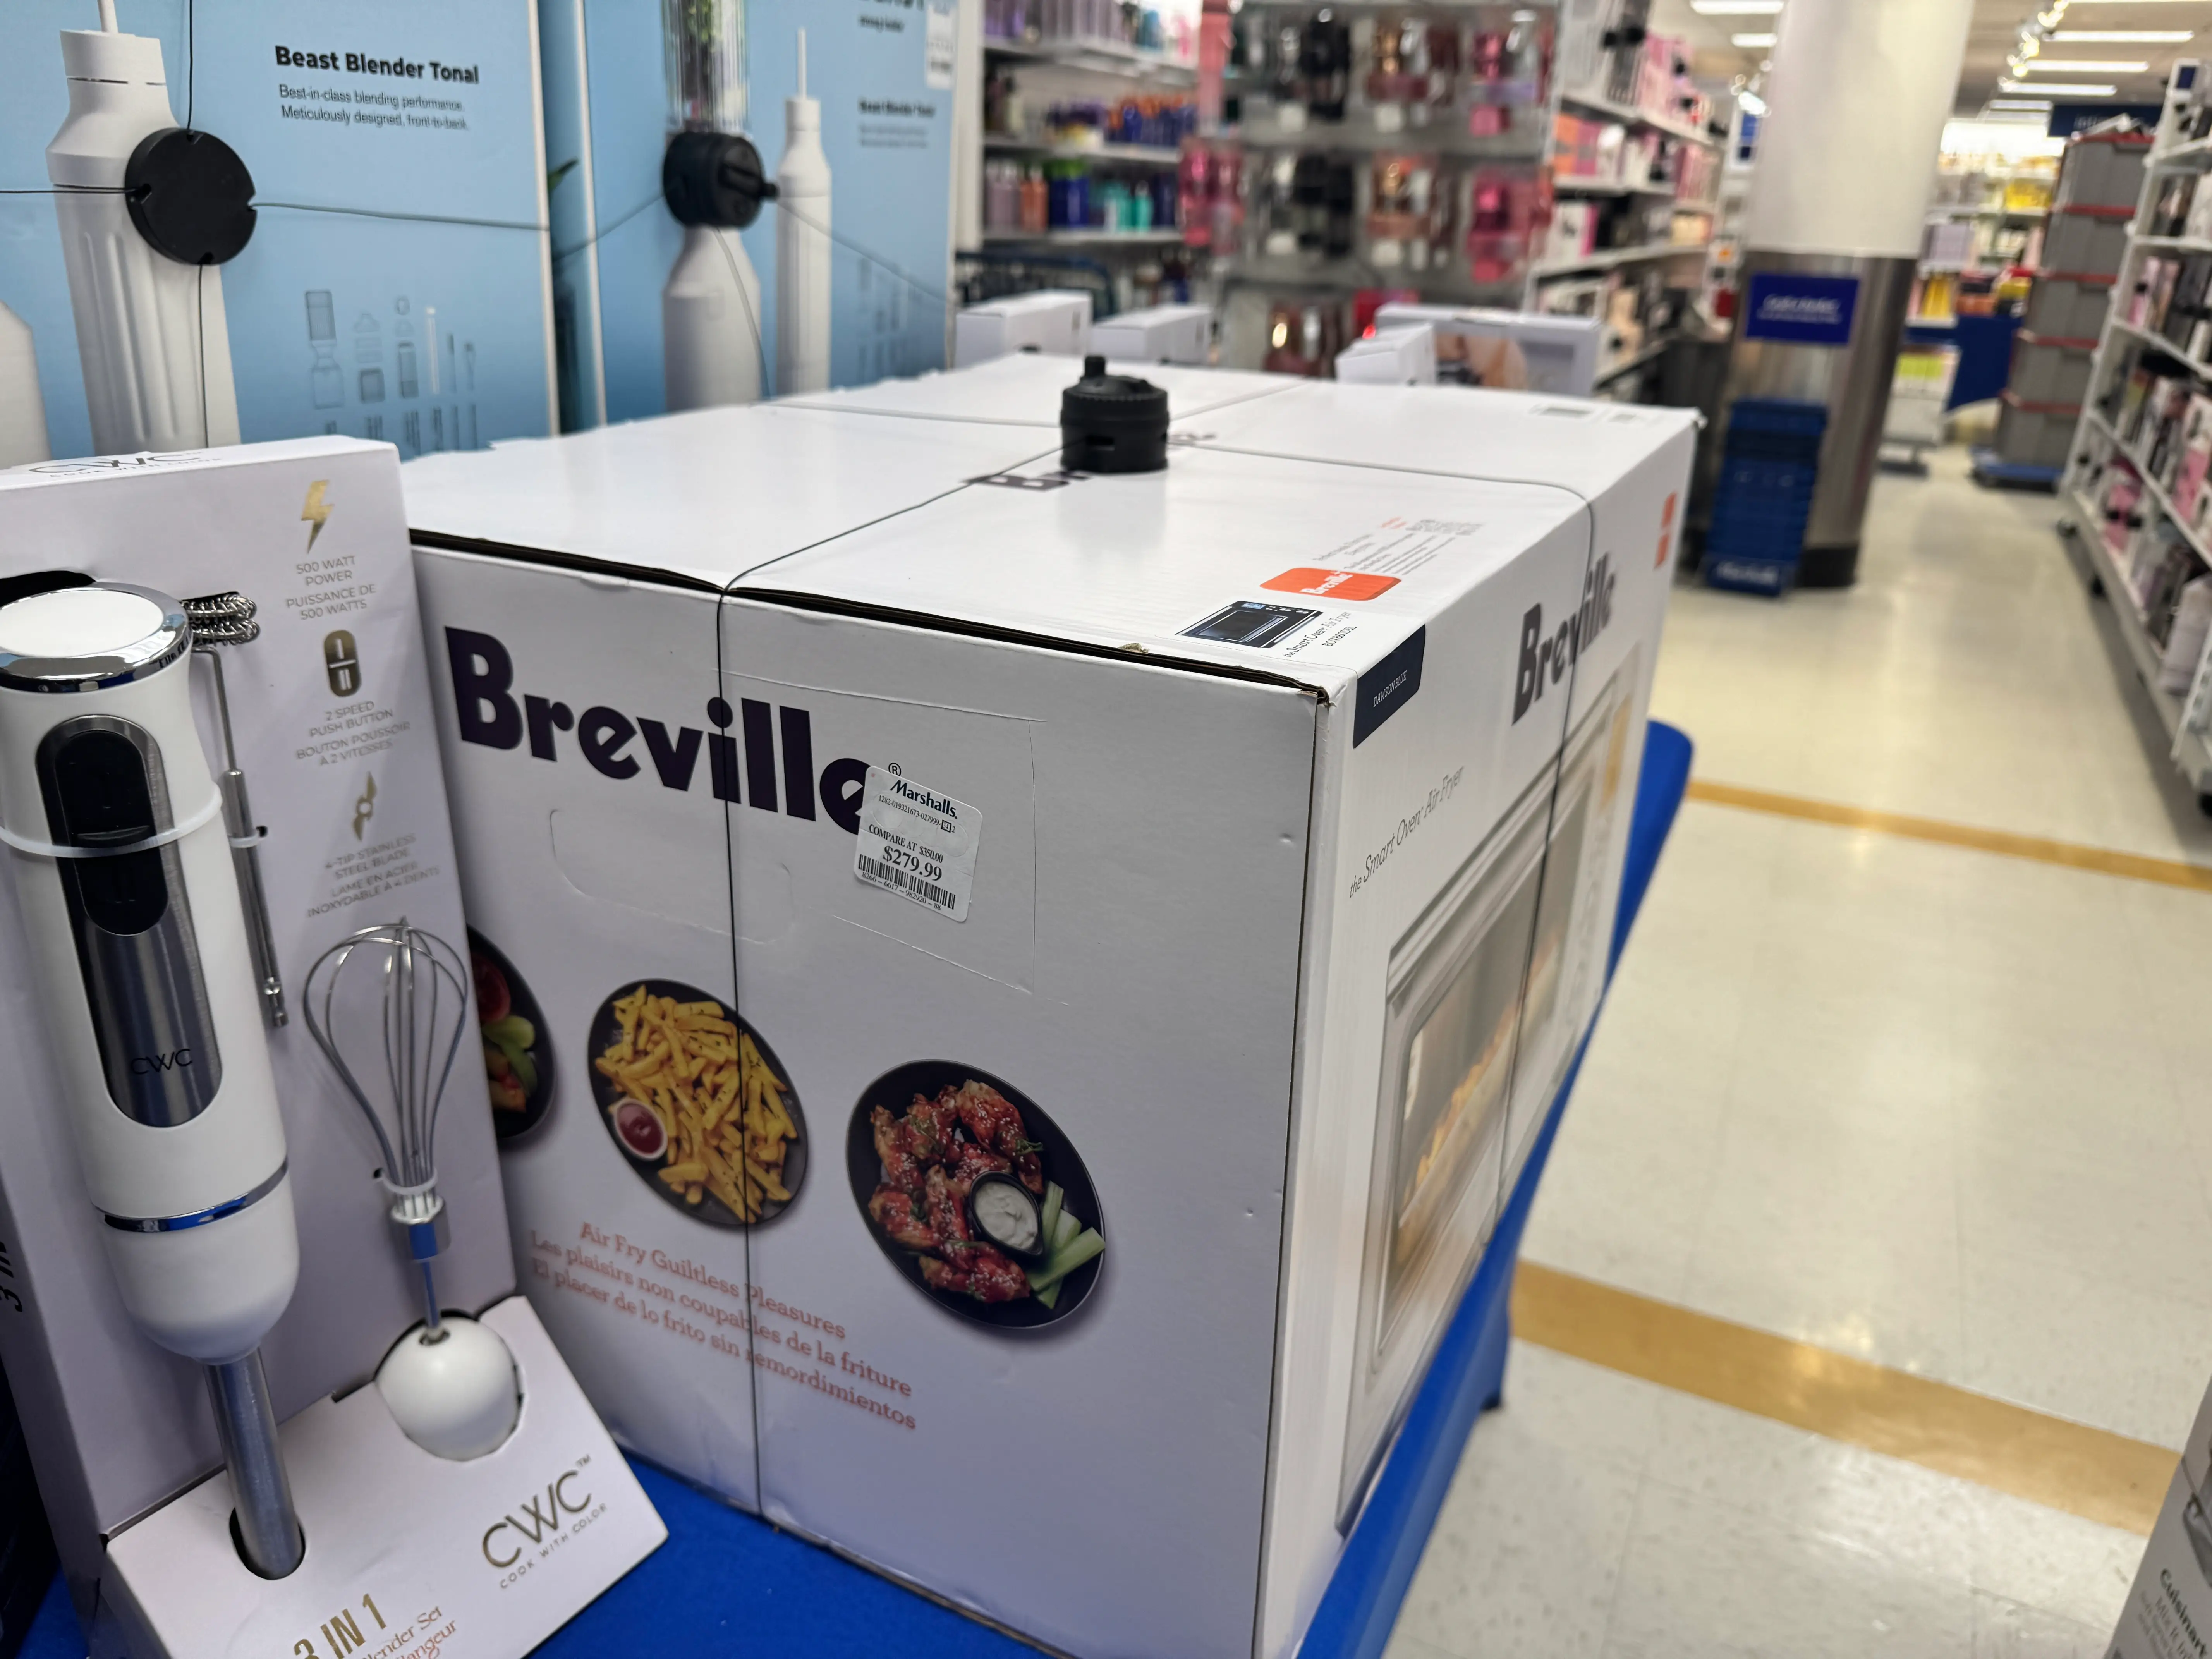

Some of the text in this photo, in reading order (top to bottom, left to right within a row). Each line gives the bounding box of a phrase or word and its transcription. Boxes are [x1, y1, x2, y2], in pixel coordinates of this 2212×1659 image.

[275, 46, 479, 84] Beast Blender Tonal
[279, 84, 351, 103] Best-in-class
[354, 89, 399, 110] blending
[281, 105, 351, 126] Meticulously
[354, 110, 405, 127] designed,
[296, 556, 356, 574] 500 WATT
[305, 569, 352, 587] POWER
[286, 584, 376, 608] PUISSANCE DE
[301, 599, 367, 620] 500 WATTS
[1286, 639, 1313, 652] Smart
[1373, 670, 1408, 708] DAMSON BLUE
[309, 709, 393, 737] PUSH BUTTON
[325, 701, 374, 721] 2 SPEED
[296, 721, 411, 759] BOUTON POUSSOIR
[869, 824, 943, 863] COMPARE AT $350.00
[1350, 875, 1362, 898] the
[1363, 833, 1395, 883] Smart
[1424, 788, 1440, 819] Air
[1439, 766, 1465, 802] Fryer
[883, 846, 942, 881] $279.99
[862, 872, 877, 883] 8266
[884, 881, 898, 891] 6617
[906, 890, 927, 904] 982920
[131, 1048, 193, 1075] CWC
[580, 1221, 846, 1339] Air Fry Guiltless Pleasures
[530, 1230, 912, 1397] Les plaisirs non coupables de la friture
[554, 1267, 610, 1303] placer
[614, 1290, 637, 1314] de
[640, 1298, 659, 1324] lo
[663, 1309, 706, 1343] frito
[711, 1333, 741, 1358] sin
[745, 1347, 917, 1430] remordimientos
[482, 1469, 592, 1568] CWC
[500, 1503, 607, 1589] COOK WITH COLOR
[320, 1608, 366, 1659] IN
[362, 1593, 386, 1630] 1
[362, 1606, 442, 1659] ender Set
